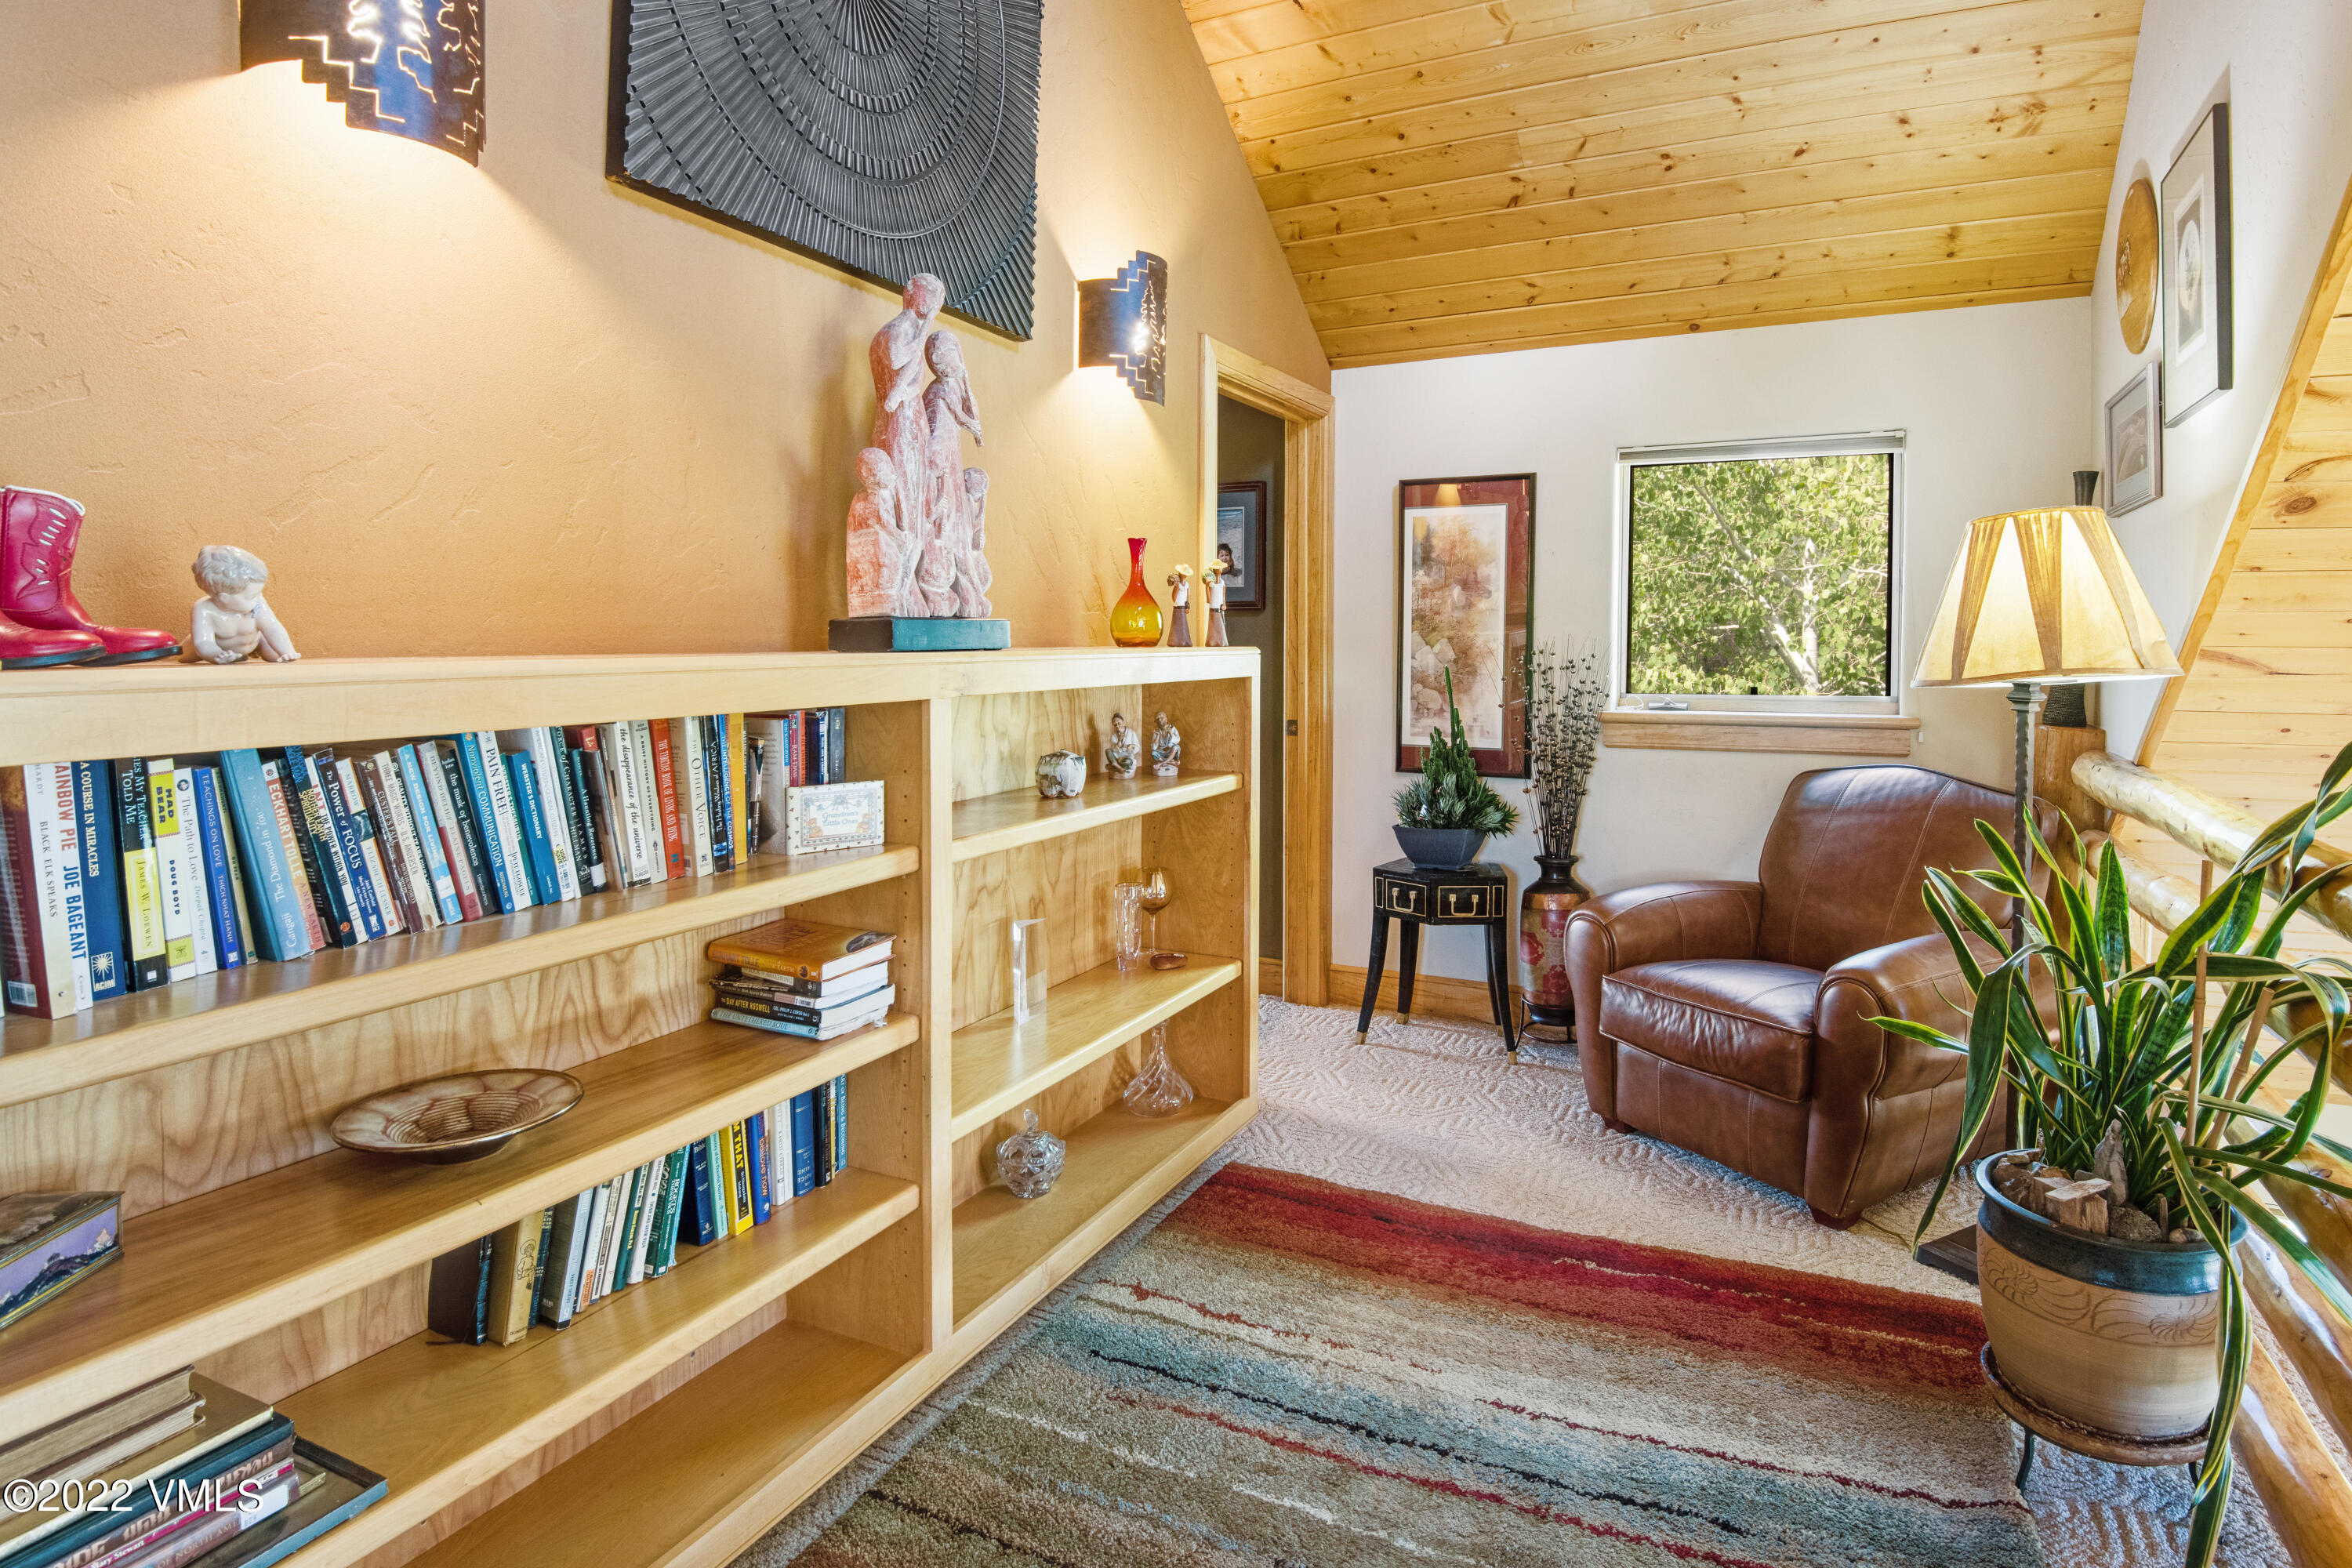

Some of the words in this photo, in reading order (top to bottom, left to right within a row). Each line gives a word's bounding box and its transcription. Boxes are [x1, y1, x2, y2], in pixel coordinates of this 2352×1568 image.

[658, 739, 667, 751] THE
[710, 742, 719, 772] AFRICA
[383, 764, 393, 782] THREE
[559, 755, 568, 764] of
[621, 745, 634, 799] disappearance
[659, 751, 671, 771] TIBETAN
[722, 749, 731, 795] INTELLIGENCE
[82, 771, 93, 811] COURSE
[122, 770, 133, 801] TOLD
[345, 774, 359, 807] MARROW
[450, 773, 459, 786] the
[486, 748, 499, 778] PAIN
[493, 780, 507, 813] FREE
[563, 767, 577, 816] CHARACTER
[662, 773, 672, 787] BOOK
[691, 758, 702, 799] OTHER
[55, 765, 74, 821] AINBOW
[157, 786, 165, 823] BEAR
[181, 797, 191, 815] The
[202, 775, 216, 826] TEACHINGS
[387, 784, 398, 803] MAGIC
[454, 788, 464, 809] mask
[468, 745, 484, 789] Nonviolent
[478, 790, 503, 867] COMMUNICATION
[521, 764, 533, 800] WEBSTER'S
[529, 800, 543, 839] DICTIONARY
[665, 796, 675, 813] LIVING
[725, 797, 731, 805] OF
[85, 813, 95, 824] IN
[125, 804, 136, 825] ME
[136, 795, 147, 840] TEACHER
[299, 791, 318, 834] SPIRITUALITY
[307, 789, 320, 817] MOTHER
[315, 818, 327, 842] EARTH
[378, 790, 394, 827] CUSTER'S
[389, 827, 399, 845] FALL
[394, 804, 405, 826] WORDS
[407, 763, 417, 781] NEW
[412, 783, 426, 814] DESIGN
[428, 831, 440, 860] LIVING
[459, 811, 466, 819] of
[626, 803, 638, 811] of
[631, 812, 640, 826] the
[666, 814, 676, 825] AND
[184, 818, 194, 840] Path
[262, 829, 270, 839] in
[268, 783, 293, 840] ECKHART
[285, 840, 303, 880] TOLLE
[329, 782, 345, 817] Power
[343, 829, 362, 869] FOCUS
[430, 755, 442, 790] BEYOND
[437, 792, 452, 821] BELIEF
[449, 826, 463, 856] ELAINE
[458, 858, 470, 891] PAGELS
[583, 797, 593, 827] Haunting
[589, 828, 597, 860] Reverence
[668, 826, 678, 842] DYING
[696, 803, 706, 840] VOICE
[41, 822, 50, 853] BLACK
[60, 829, 77, 851] PIE
[187, 843, 194, 853] to
[211, 829, 219, 842] ON
[462, 819, 478, 866] benevolence
[570, 826, 582, 862] HILLMAN
[577, 823, 586, 859] JAMES
[633, 828, 642, 859] universe
[86, 827, 99, 877] MIRACLES
[212, 844, 222, 867] LOVE
[261, 839, 281, 883] Diamond
[325, 826, 336, 848] POWER
[332, 849, 344, 872] WITHIN
[339, 873, 348, 886] YOU
[405, 844, 419, 875] ANDERSEN
[45, 859, 53, 877] ELK
[63, 866, 80, 890] JOE
[137, 861, 146, 889] JAMES
[188, 856, 198, 880] Love
[366, 847, 383, 888] ELIZABETH
[379, 891, 391, 914] LESSER
[217, 876, 226, 897] THICH
[275, 883, 285, 902] The
[499, 871, 509, 897] ROSENBERG
[515, 870, 525, 895] EGOSCUE
[47, 880, 57, 917] SPEAKS
[141, 892, 150, 905] W.
[194, 886, 204, 912] Deepak
[221, 898, 230, 916] NHAT
[66, 895, 86, 959] BAGEANT
[143, 908, 152, 947] LOEWEN
[198, 914, 207, 940] Chopra
[282, 913, 296, 947] Gangaji
[302, 891, 313, 909] NEW
[309, 913, 321, 942] EARTH
[225, 920, 234, 942] HANH
[742, 956, 759, 966] TOLLE
[95, 979, 114, 989] ACIM
[726, 997, 735, 1006] DAY
[735, 1000, 748, 1008] AFTER
[750, 1002, 770, 1013] ROSWELL
[733, 1012, 772, 1027] UNTETHERED
[771, 1020, 788, 1032] SOUL
[694, 1144, 706, 1153] Bible
[734, 1138, 744, 1168] THAT
[670, 1178, 680, 1214] ROGET'S
[90, 1556, 113, 1568] Mary
[114, 1540, 145, 1559] Stewart
[176, 1535, 214, 1561] NORTH
